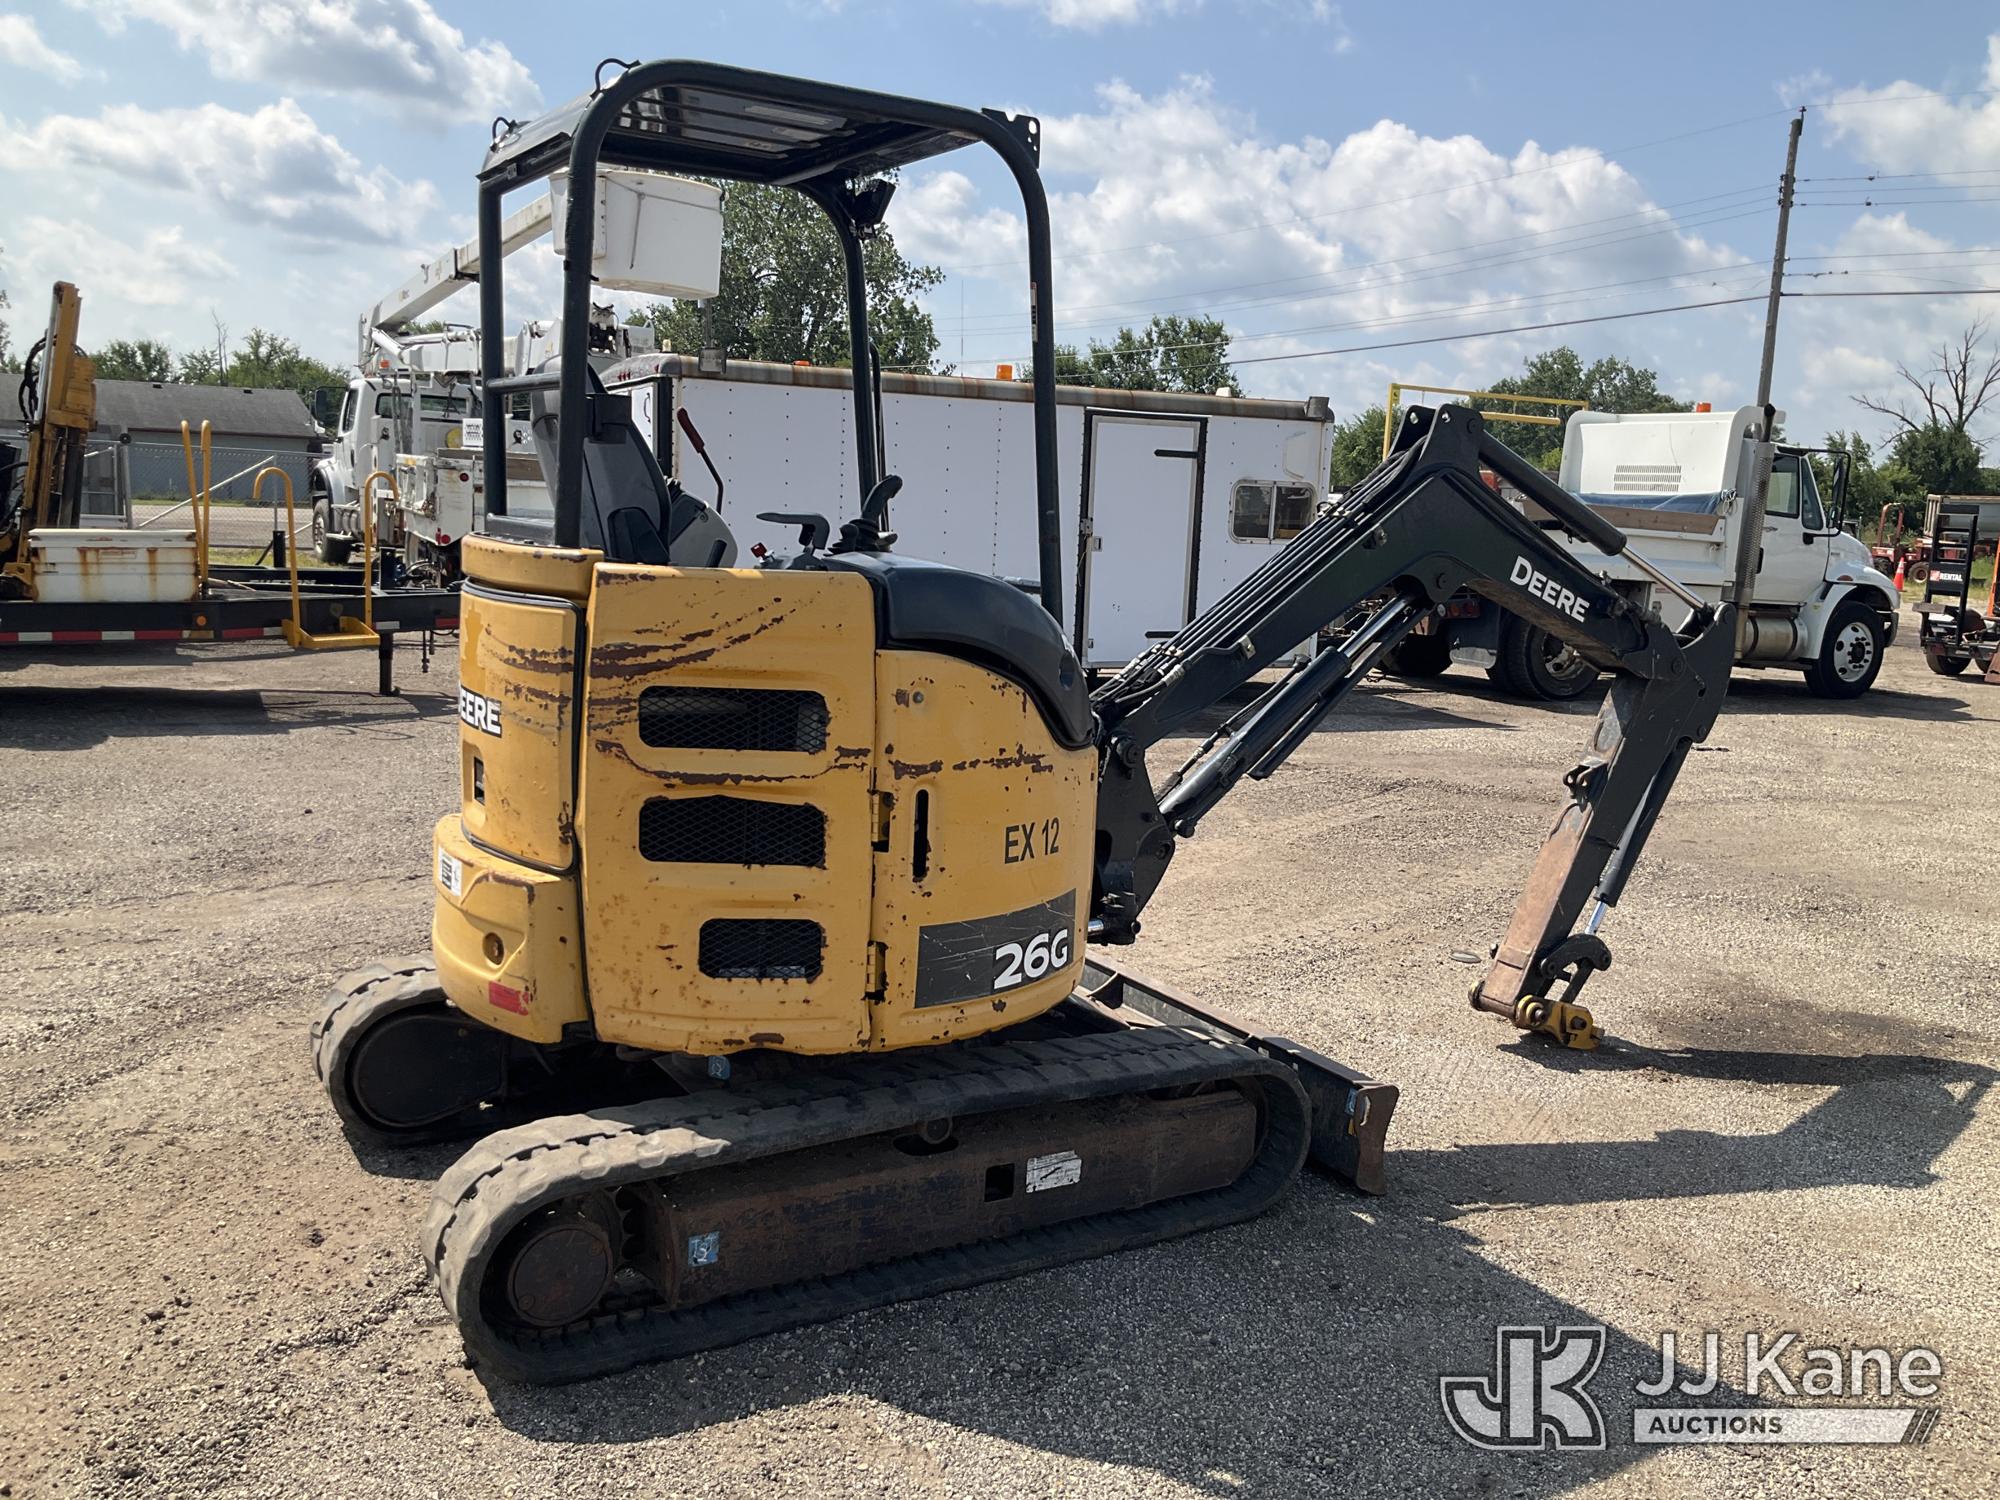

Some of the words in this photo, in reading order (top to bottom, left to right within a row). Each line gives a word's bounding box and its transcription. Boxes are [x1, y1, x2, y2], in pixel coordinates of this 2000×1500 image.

[1510, 555, 1590, 623] DEERE
[459, 686, 502, 737] EERE
[1005, 822, 1035, 864] EX
[1042, 817, 1060, 855] 12
[994, 928, 1068, 990] 26G
